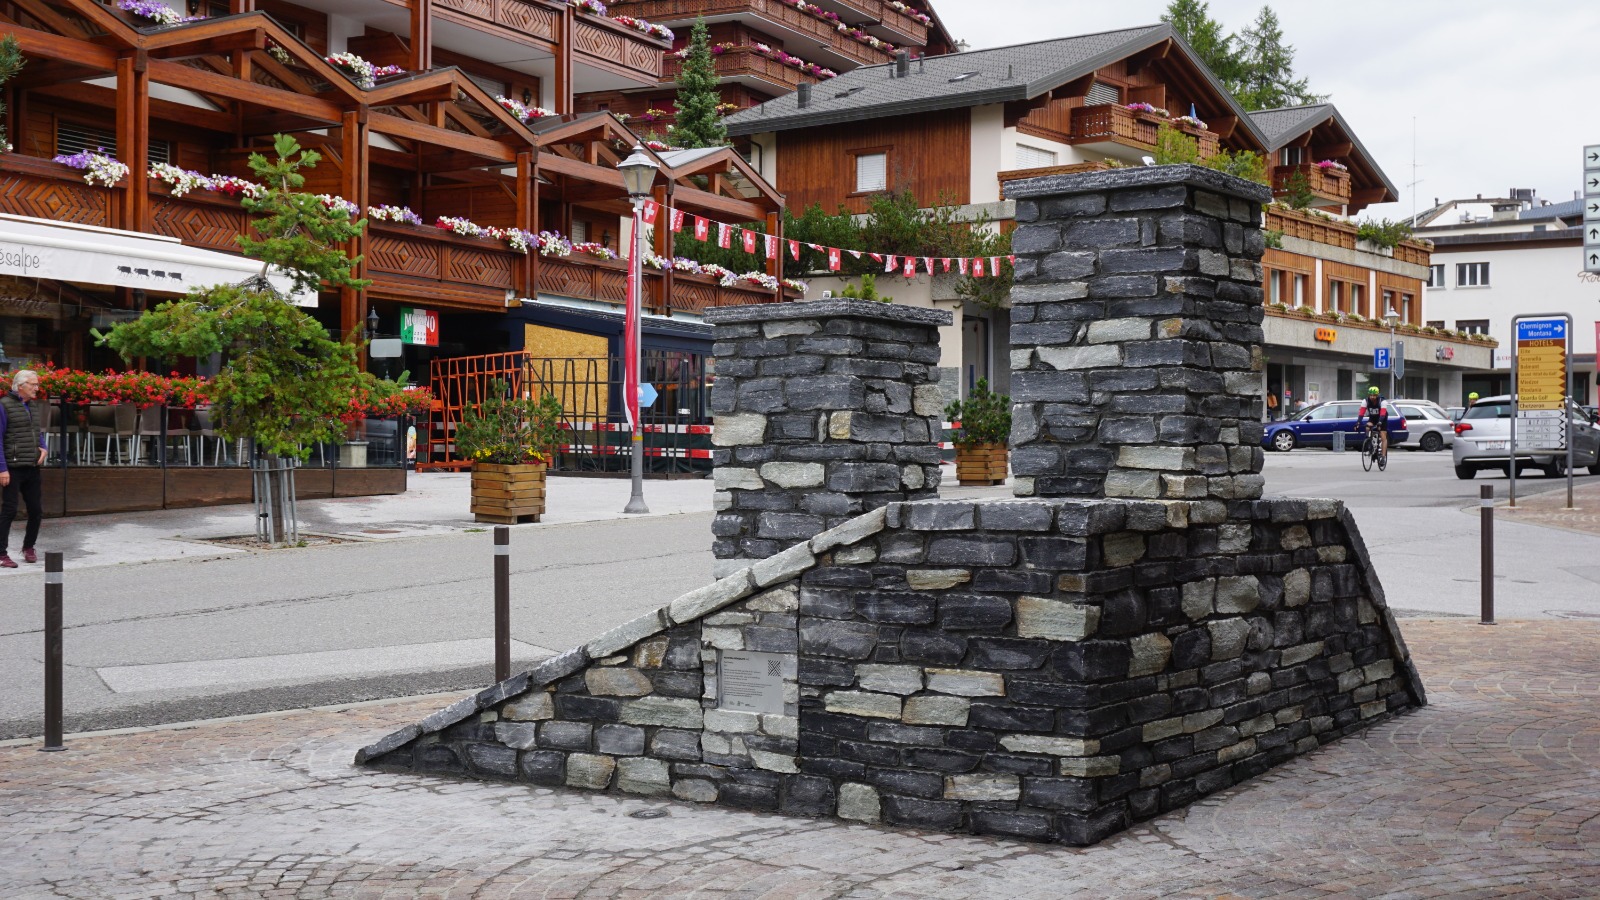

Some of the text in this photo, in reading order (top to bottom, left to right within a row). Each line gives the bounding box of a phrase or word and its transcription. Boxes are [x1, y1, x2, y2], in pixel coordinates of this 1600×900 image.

[1520, 322, 1552, 331] Chermignon
[1315, 328, 1337, 344] coop
[1529, 339, 1554, 347] HOTELS
